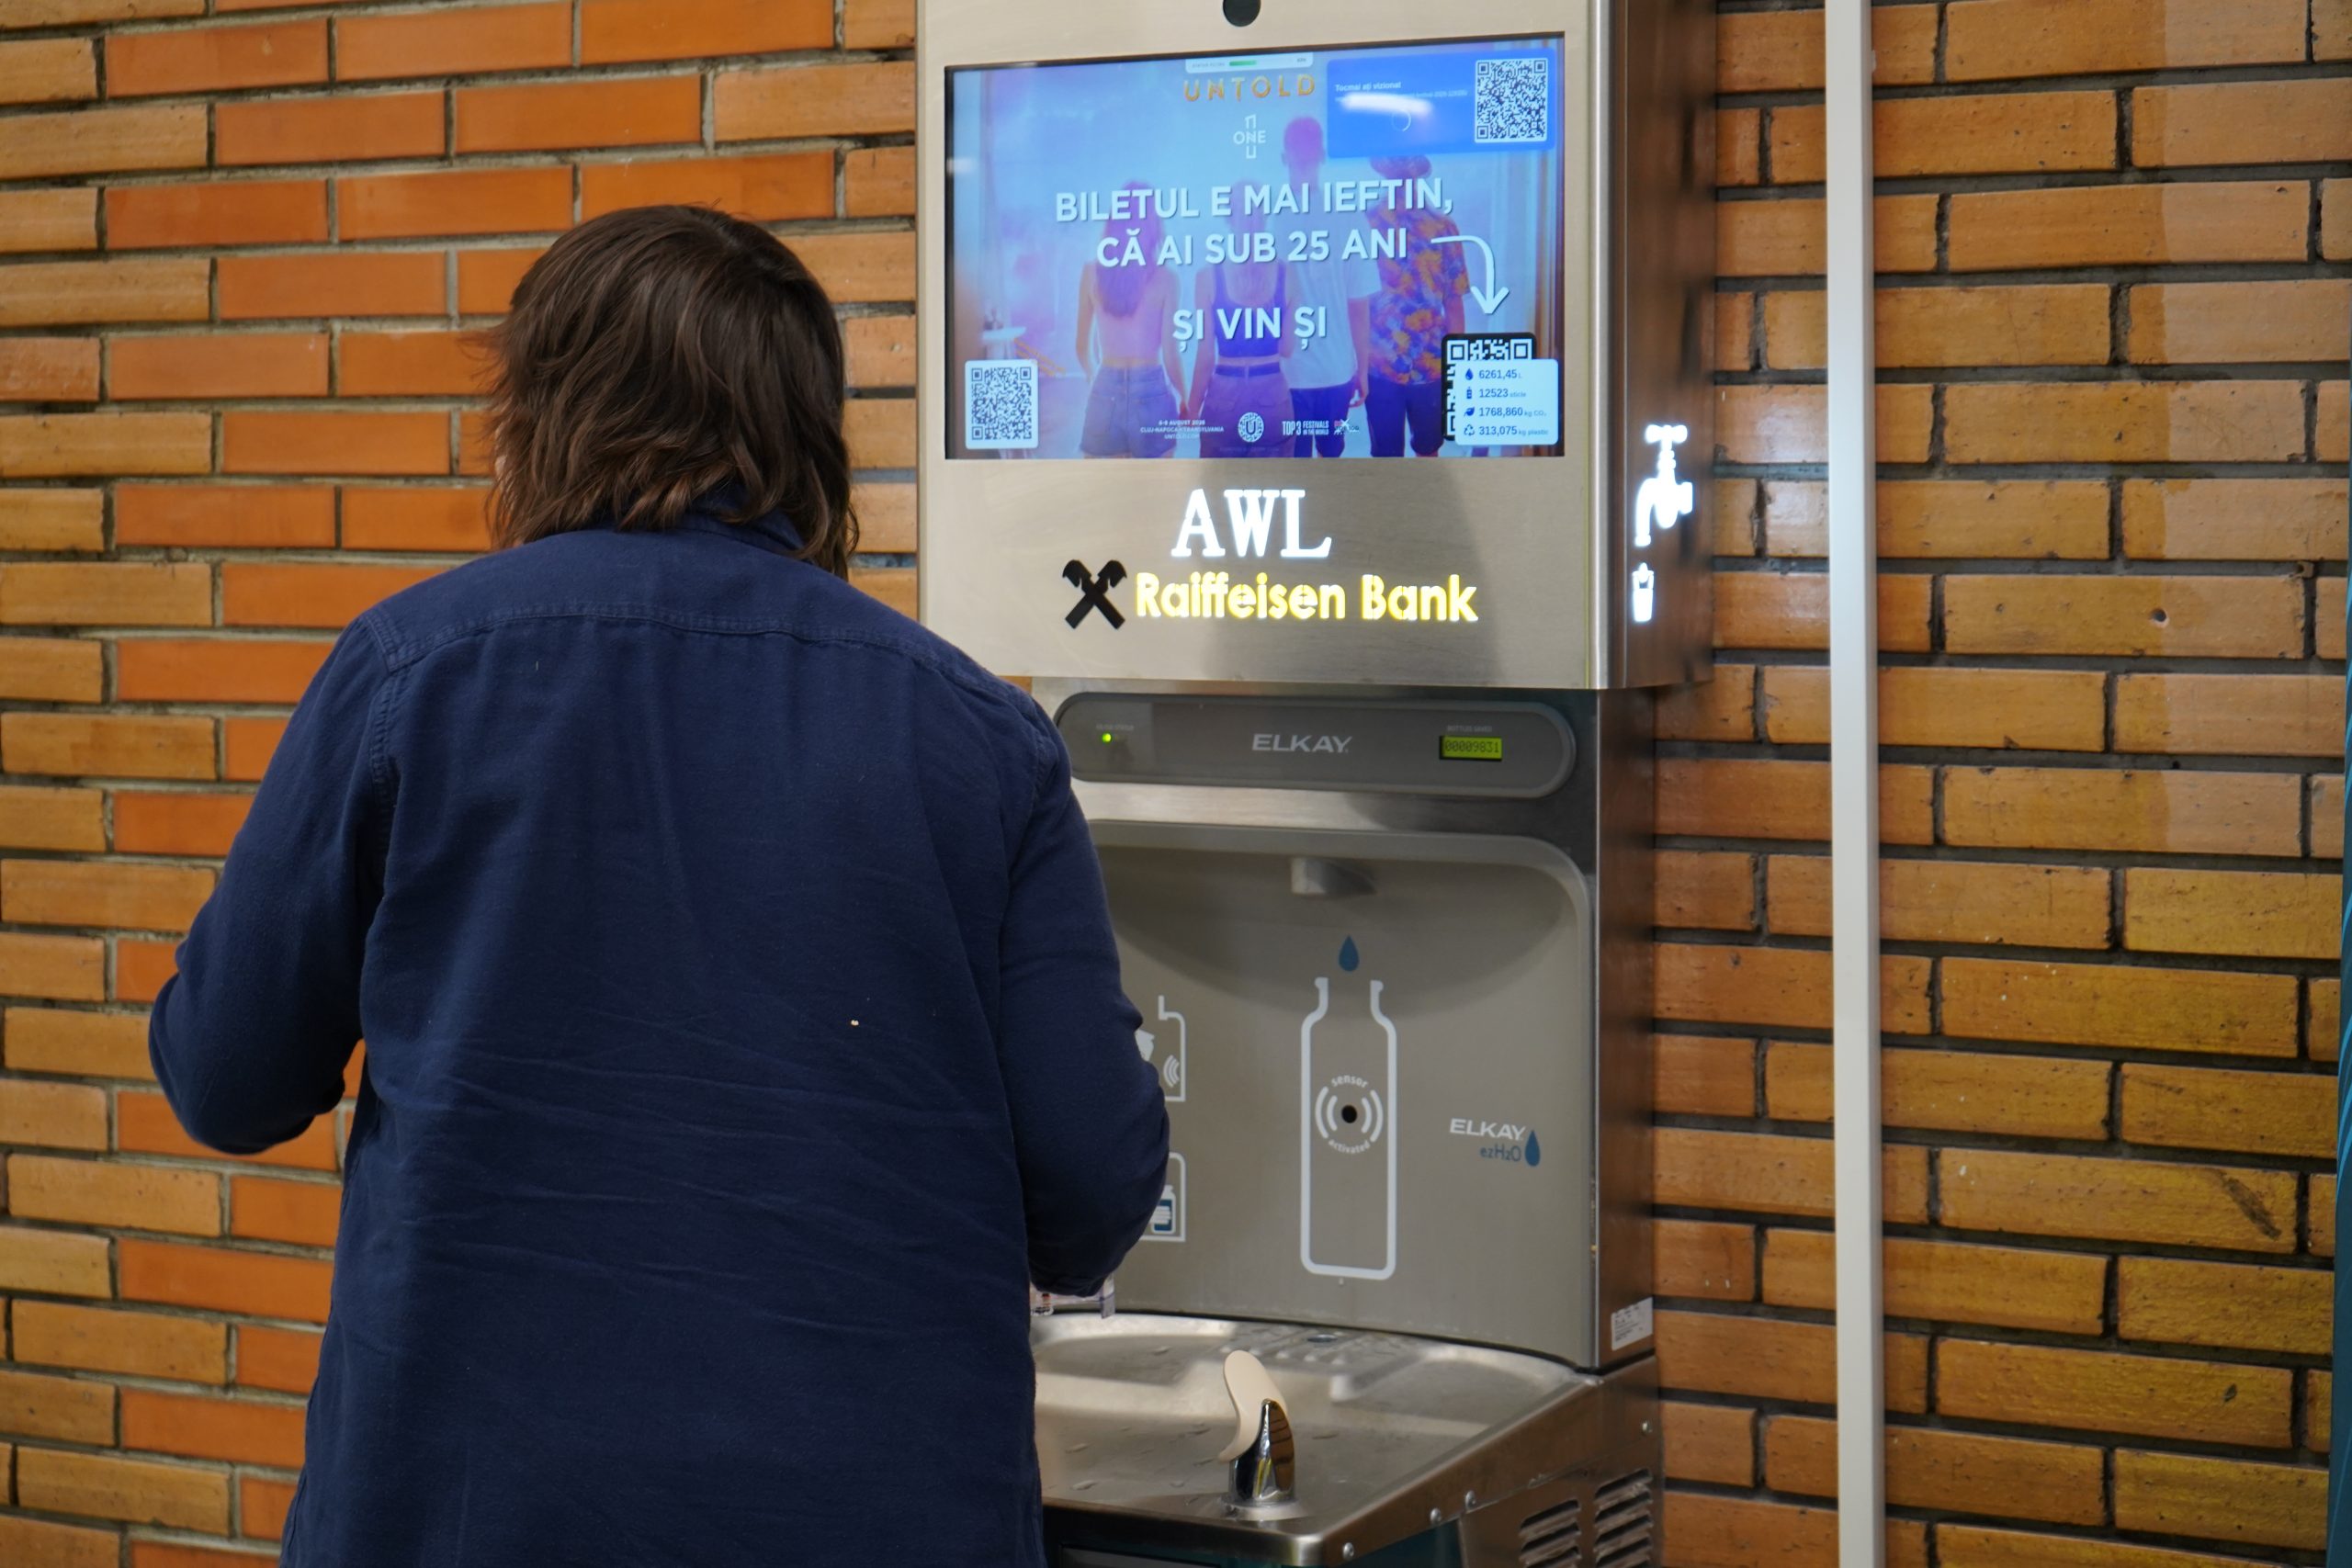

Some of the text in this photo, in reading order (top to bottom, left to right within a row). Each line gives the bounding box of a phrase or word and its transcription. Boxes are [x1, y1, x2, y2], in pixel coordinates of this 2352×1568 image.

[1183, 73, 1316, 102] UNTOLD
[1232, 130, 1266, 145] ONE
[1056, 176, 1454, 222] BILETUL E MAI IEFTIN,
[1096, 227, 1408, 268] CĂ AI SUB 25 ANI
[1171, 305, 1328, 353] ȘI VIN ȘI
[1478, 368, 1518, 380] 6261,45
[1478, 388, 1509, 398] 12523
[1478, 407, 1523, 418] 1768,860
[1283, 420, 1302, 436] TOP 3
[1303, 420, 1329, 429] FESTIVALS
[1478, 425, 1518, 436] 313,075
[1170, 487, 1332, 558] AWL
[1136, 571, 1478, 622] Raiffeisen Bank
[1251, 733, 1352, 753] ELKAY
[1331, 1075, 1368, 1088] sensor
[1450, 1117, 1526, 1141] ELKAY
[1329, 1139, 1371, 1154] activated
